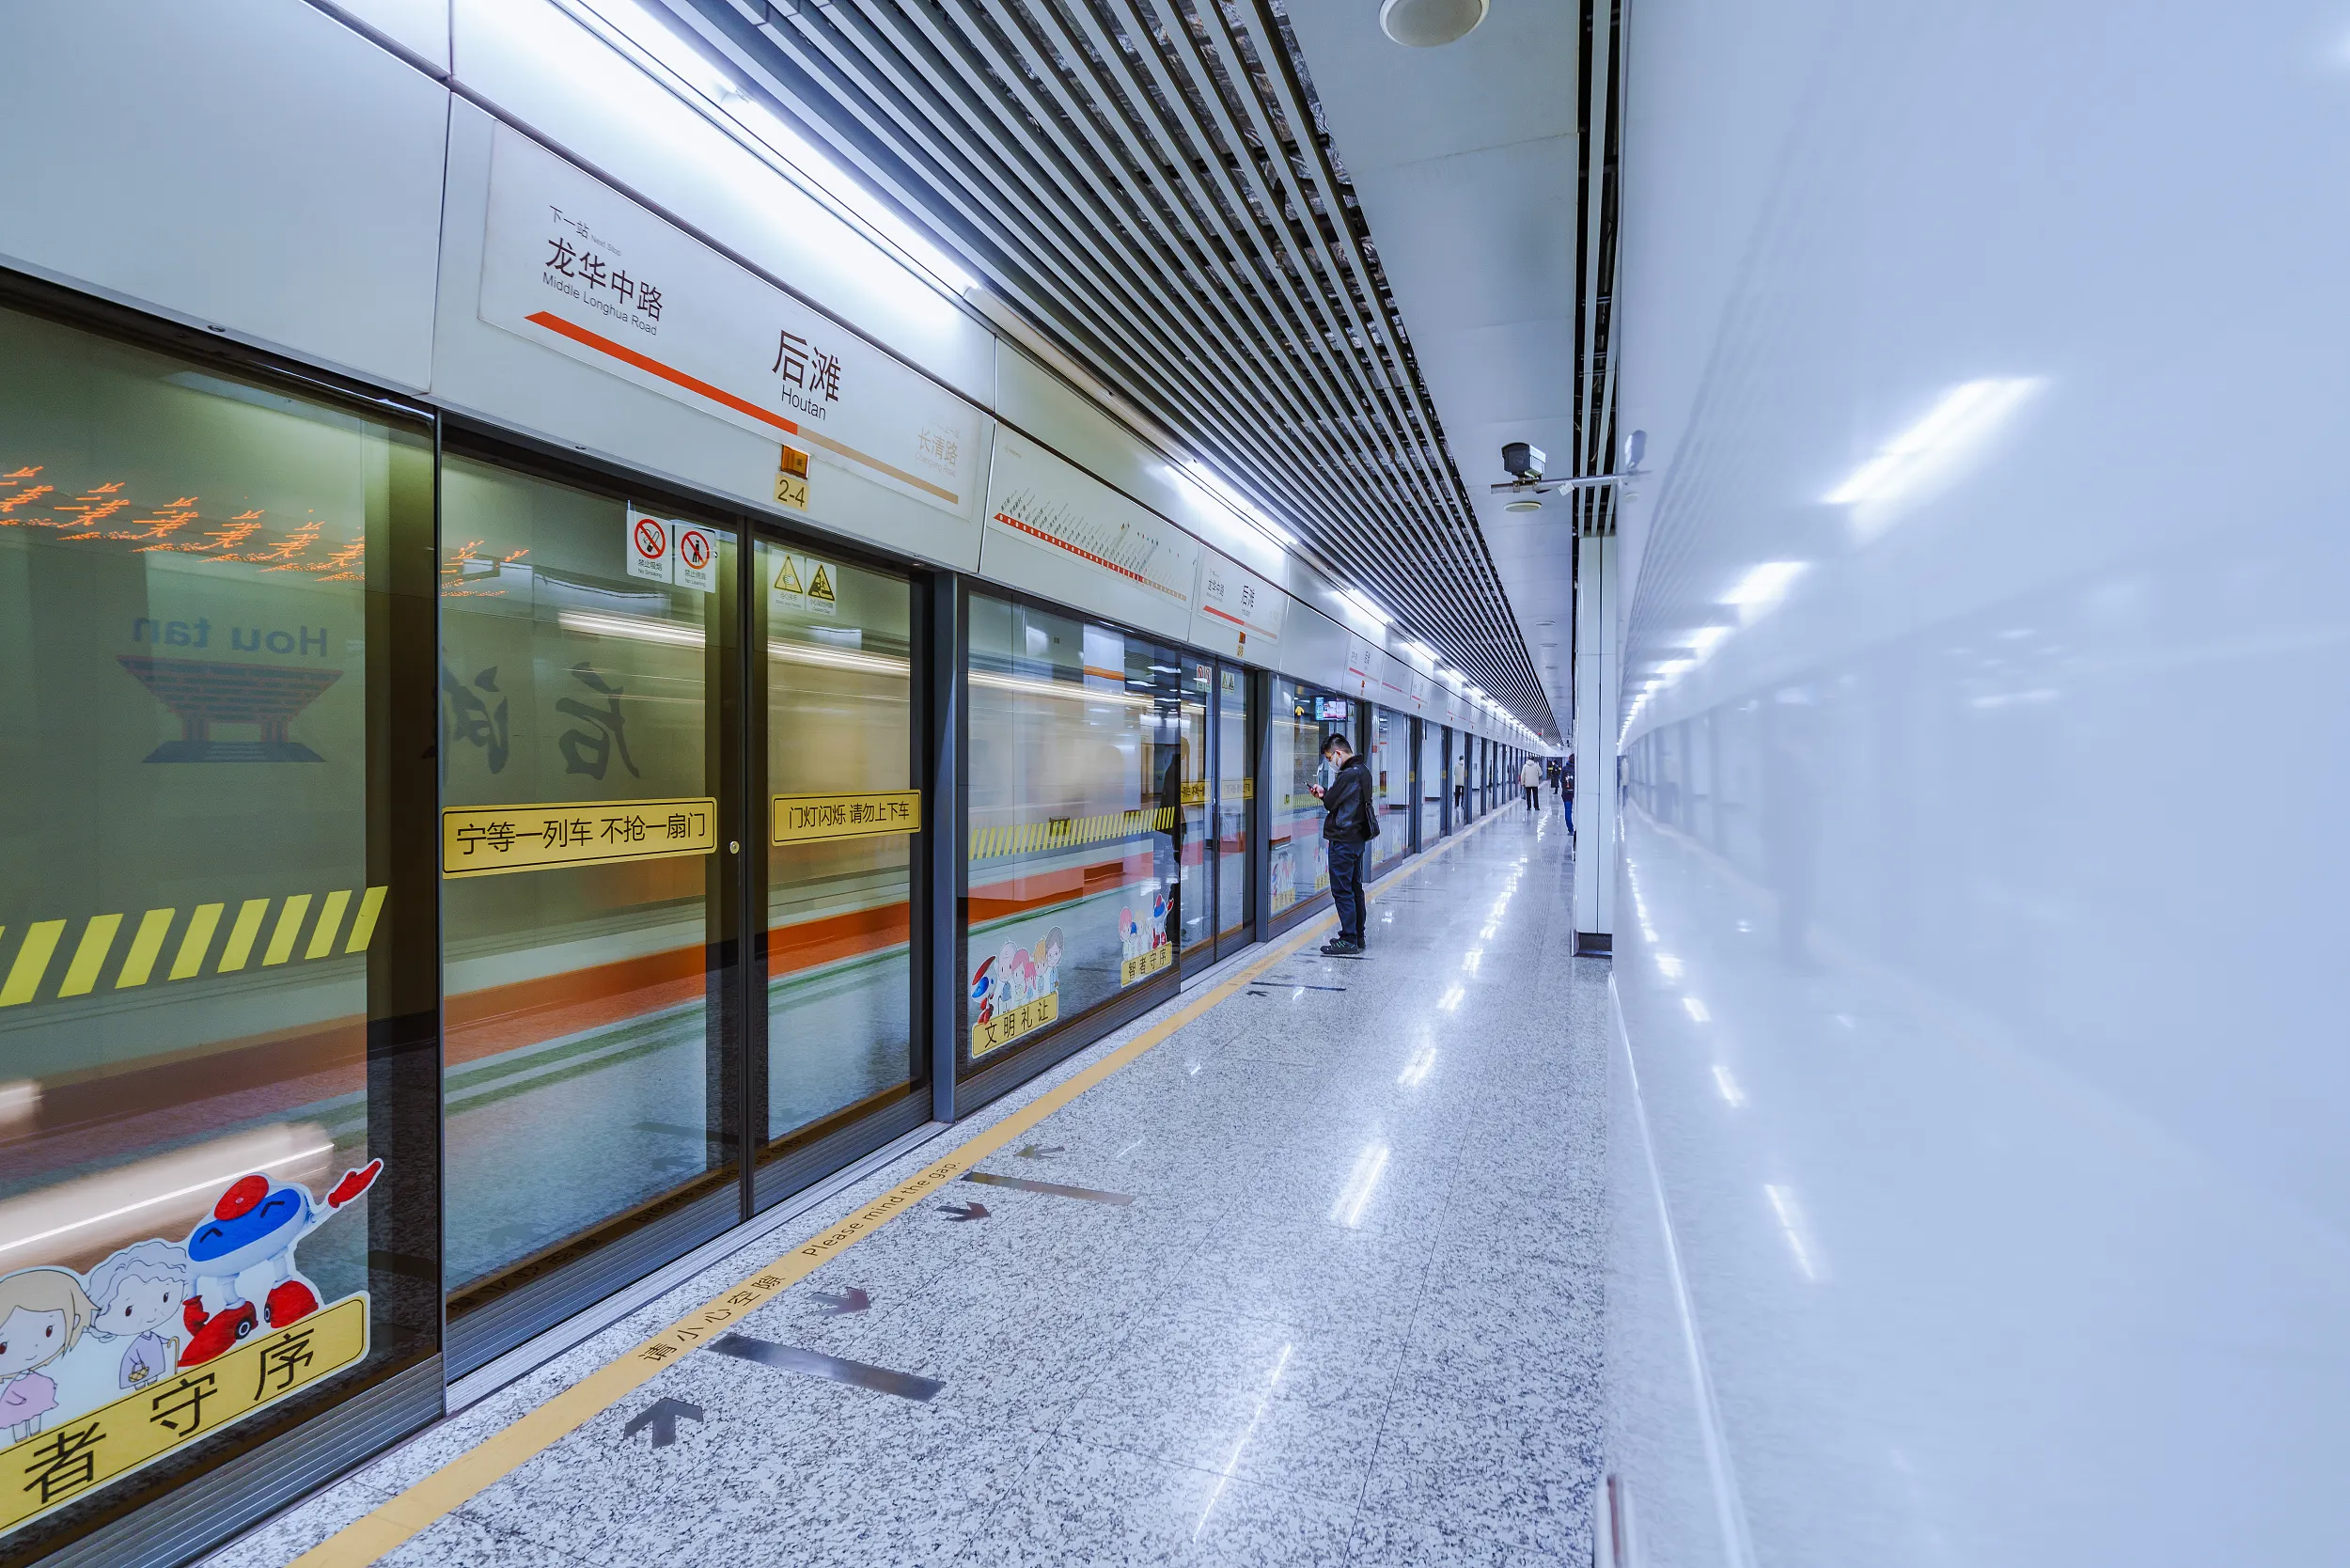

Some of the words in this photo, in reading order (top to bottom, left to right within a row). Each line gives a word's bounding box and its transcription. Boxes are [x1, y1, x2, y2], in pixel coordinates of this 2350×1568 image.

[550, 205, 589, 240] 下一站
[545, 237, 663, 322] 龙华中路
[542, 272, 580, 299] Middle
[583, 290, 629, 322] Longhua
[631, 314, 657, 337] Road
[772, 329, 841, 402] 后滩
[781, 384, 826, 421] Houtan
[918, 426, 958, 467] 长清路
[777, 479, 805, 508] 2-4
[456, 817, 593, 856] 宁等一列车
[600, 811, 705, 845] 不抢一扇门
[788, 803, 846, 830] 门灯闪烁
[850, 801, 910, 825] 请勿上下车
[1128, 948, 1167, 981] 智者守序
[984, 1000, 1050, 1048] 文明礼让
[801, 1222, 864, 1257] Please
[863, 1196, 905, 1222] mind
[900, 1180, 931, 1198] the
[929, 1161, 961, 1181] gap.
[638, 1274, 787, 1362] 请小心空隙
[23, 1327, 315, 1505] 者守序
